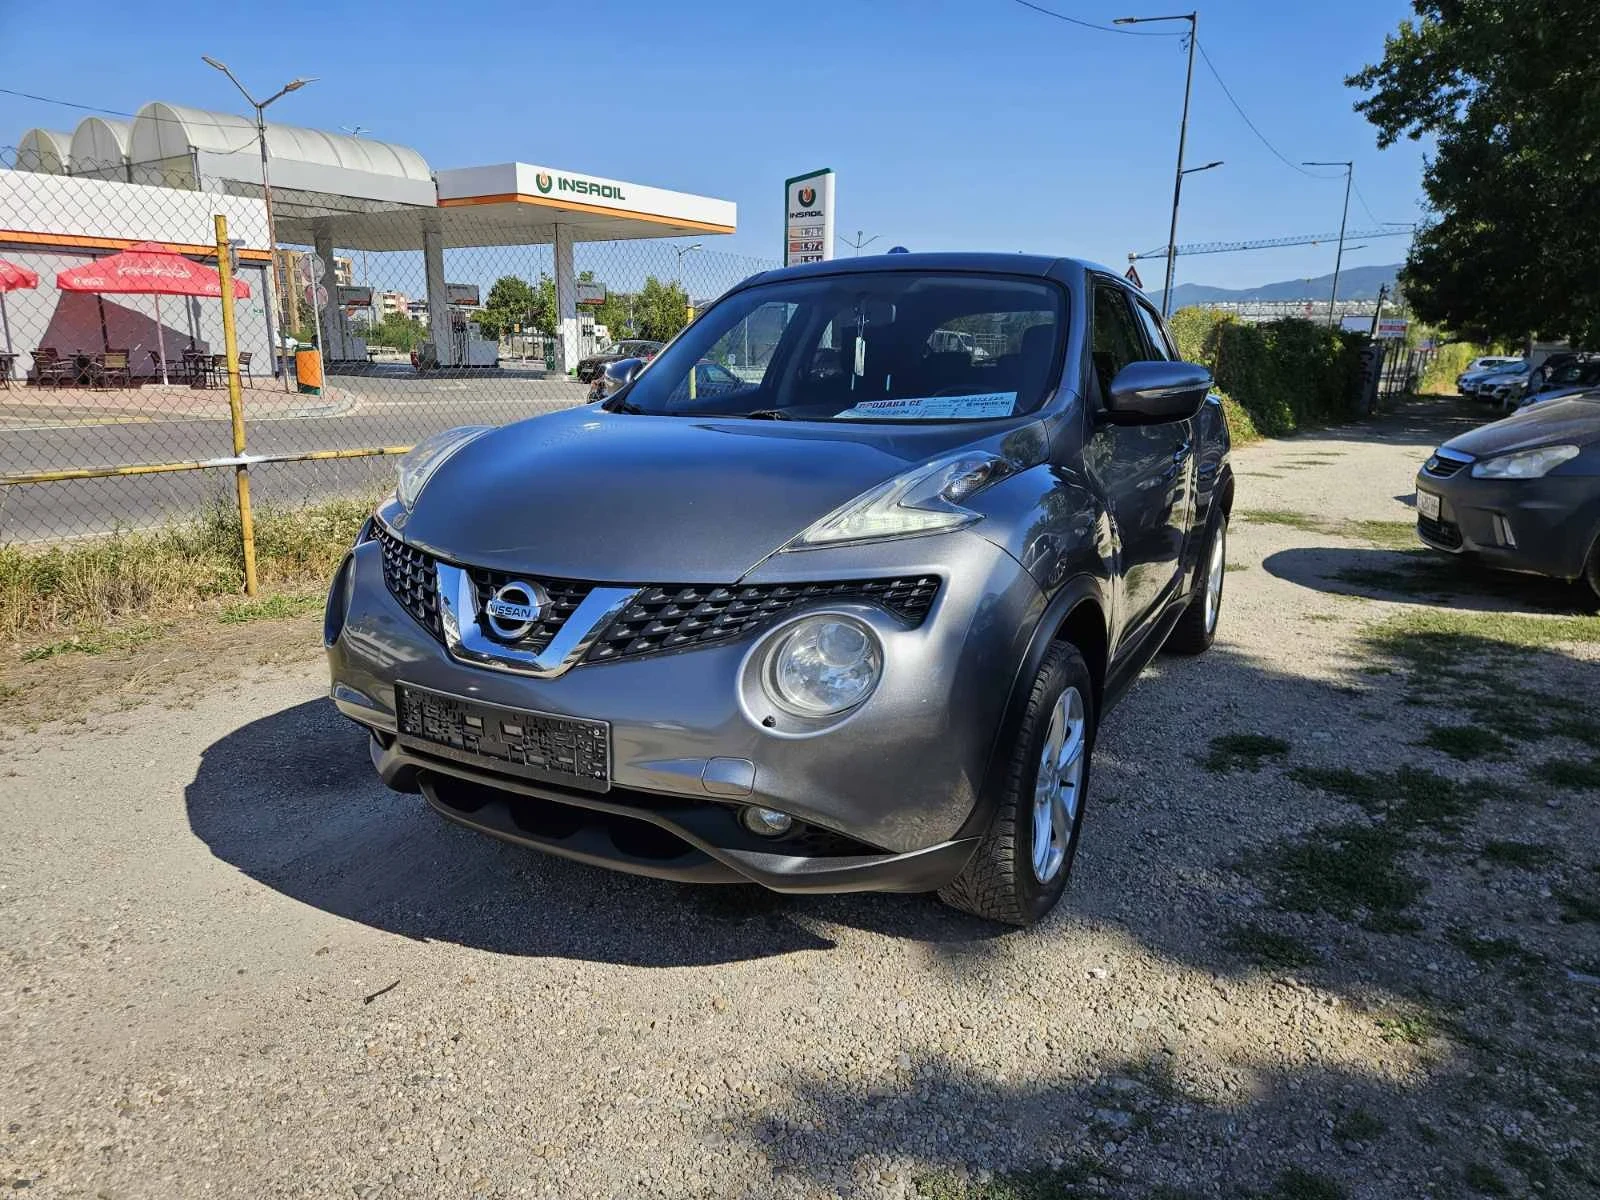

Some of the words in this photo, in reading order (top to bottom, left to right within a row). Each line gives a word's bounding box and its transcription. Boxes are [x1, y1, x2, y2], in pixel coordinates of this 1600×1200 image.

[558, 177, 626, 201] INSAOIL
[789, 210, 824, 219] INSAOIL
[490, 603, 532, 618] NISSAN
